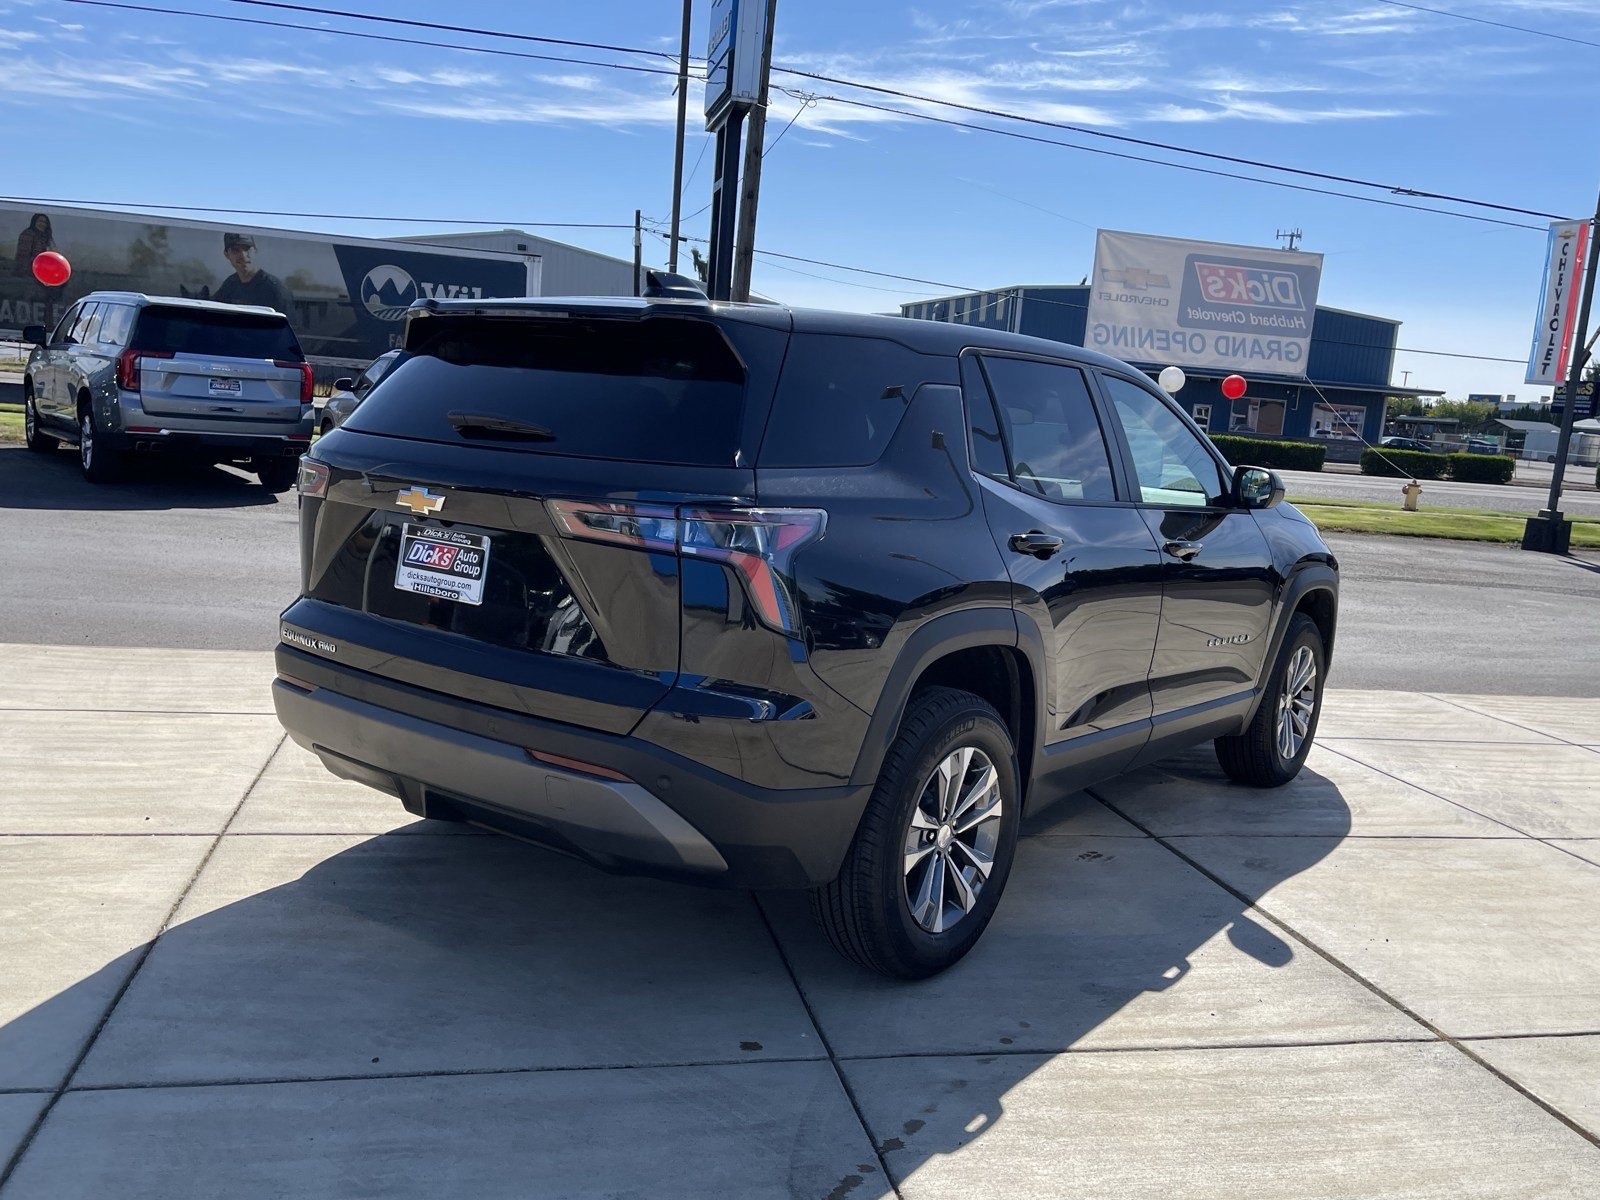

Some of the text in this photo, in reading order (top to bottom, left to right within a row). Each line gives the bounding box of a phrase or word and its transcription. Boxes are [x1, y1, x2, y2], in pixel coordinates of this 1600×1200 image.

[1541, 242, 1570, 376] CHEVROLET
[424, 528, 450, 539] Dick's
[408, 544, 452, 566] Dick's
[456, 549, 479, 563] Auto
[453, 560, 480, 577] Group
[406, 571, 472, 590] dicksautogroup.com
[413, 583, 459, 599] Hillsboro
[282, 628, 318, 649] EQUINOX
